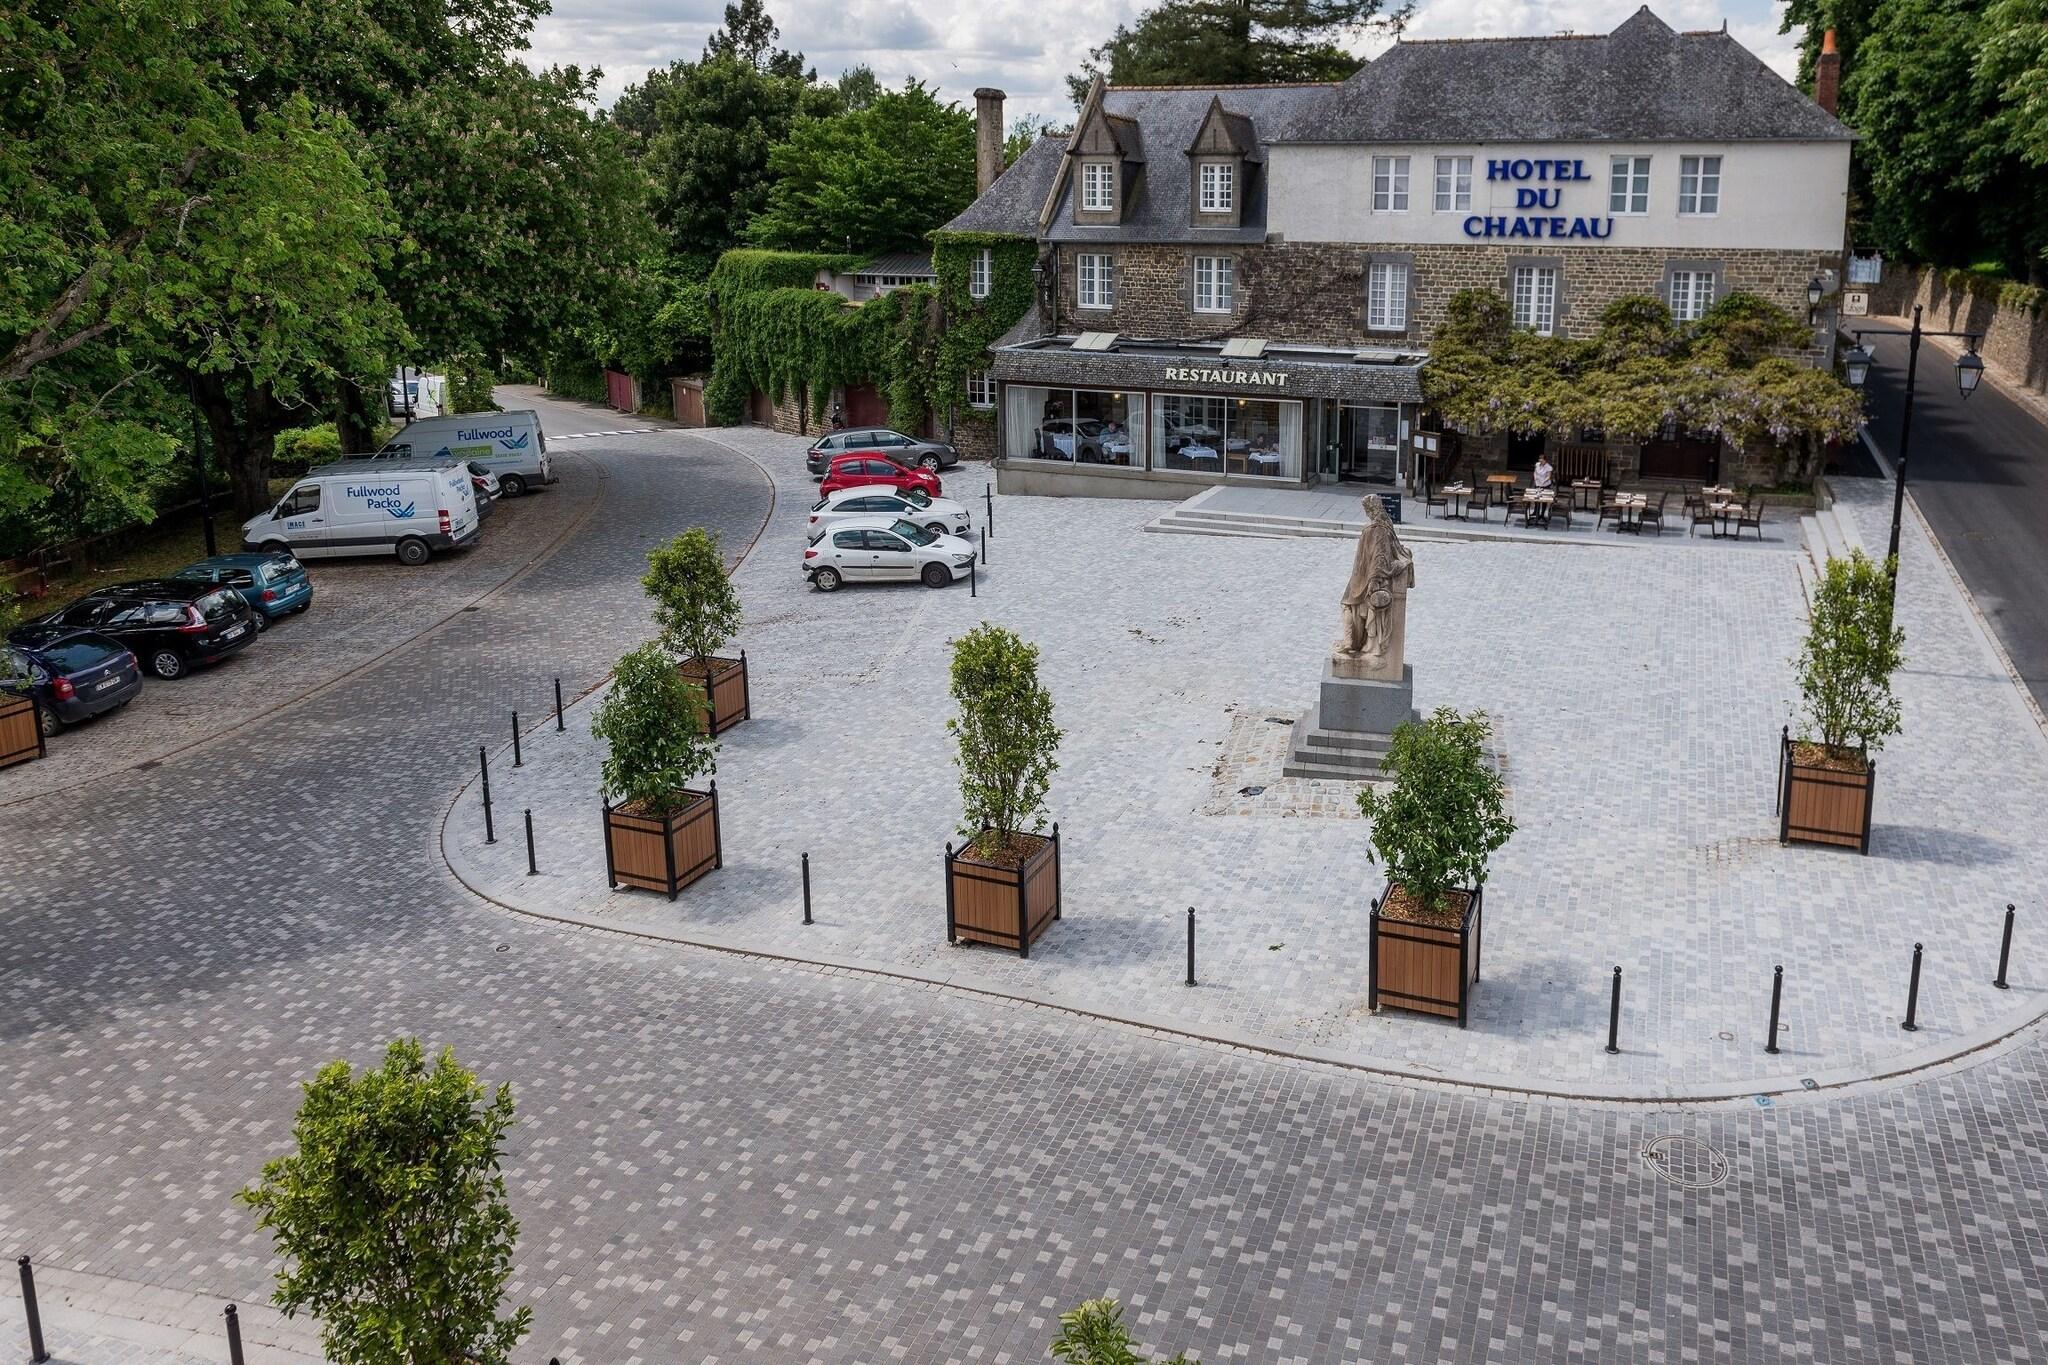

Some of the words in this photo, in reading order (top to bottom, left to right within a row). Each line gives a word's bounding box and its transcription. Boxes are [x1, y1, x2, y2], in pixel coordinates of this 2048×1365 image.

[1487, 159, 1592, 181] HOTEL
[1516, 188, 1562, 209] DU
[1463, 216, 1615, 239] CHATEAU
[1165, 367, 1289, 386] RESTAURANT
[457, 426, 513, 441] Fullwood
[347, 484, 400, 498] Fullwood
[367, 497, 402, 509] Packo
